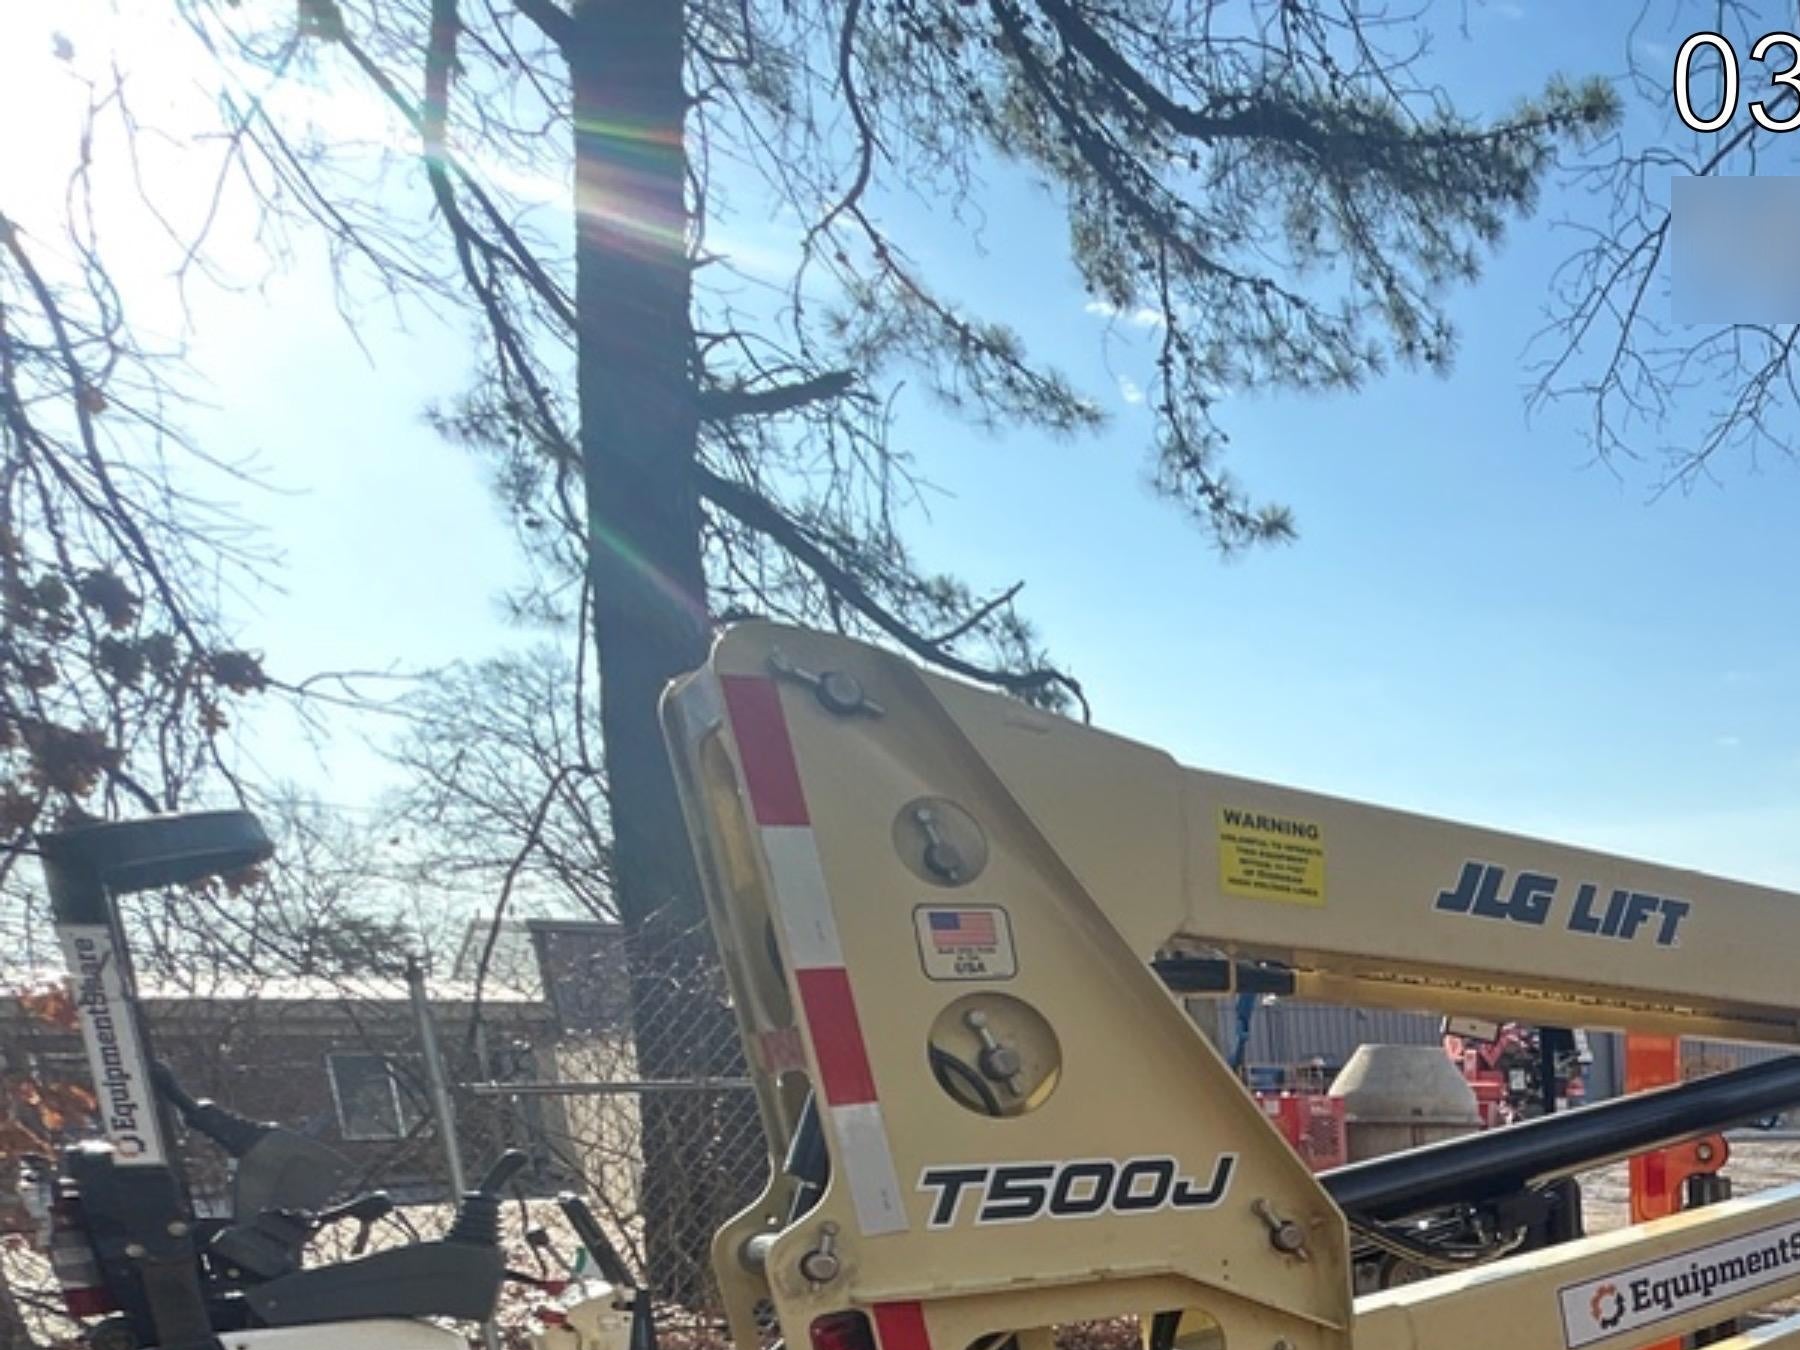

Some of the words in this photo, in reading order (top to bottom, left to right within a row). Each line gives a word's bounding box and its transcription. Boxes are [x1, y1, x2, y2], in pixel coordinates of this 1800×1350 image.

[1222, 807, 1319, 840] WARNING
[1435, 862, 1559, 926] JLG
[1566, 883, 1691, 946] LIFT
[74, 937, 138, 1132] EquipmentShare
[922, 1156, 1234, 1225] T500J
